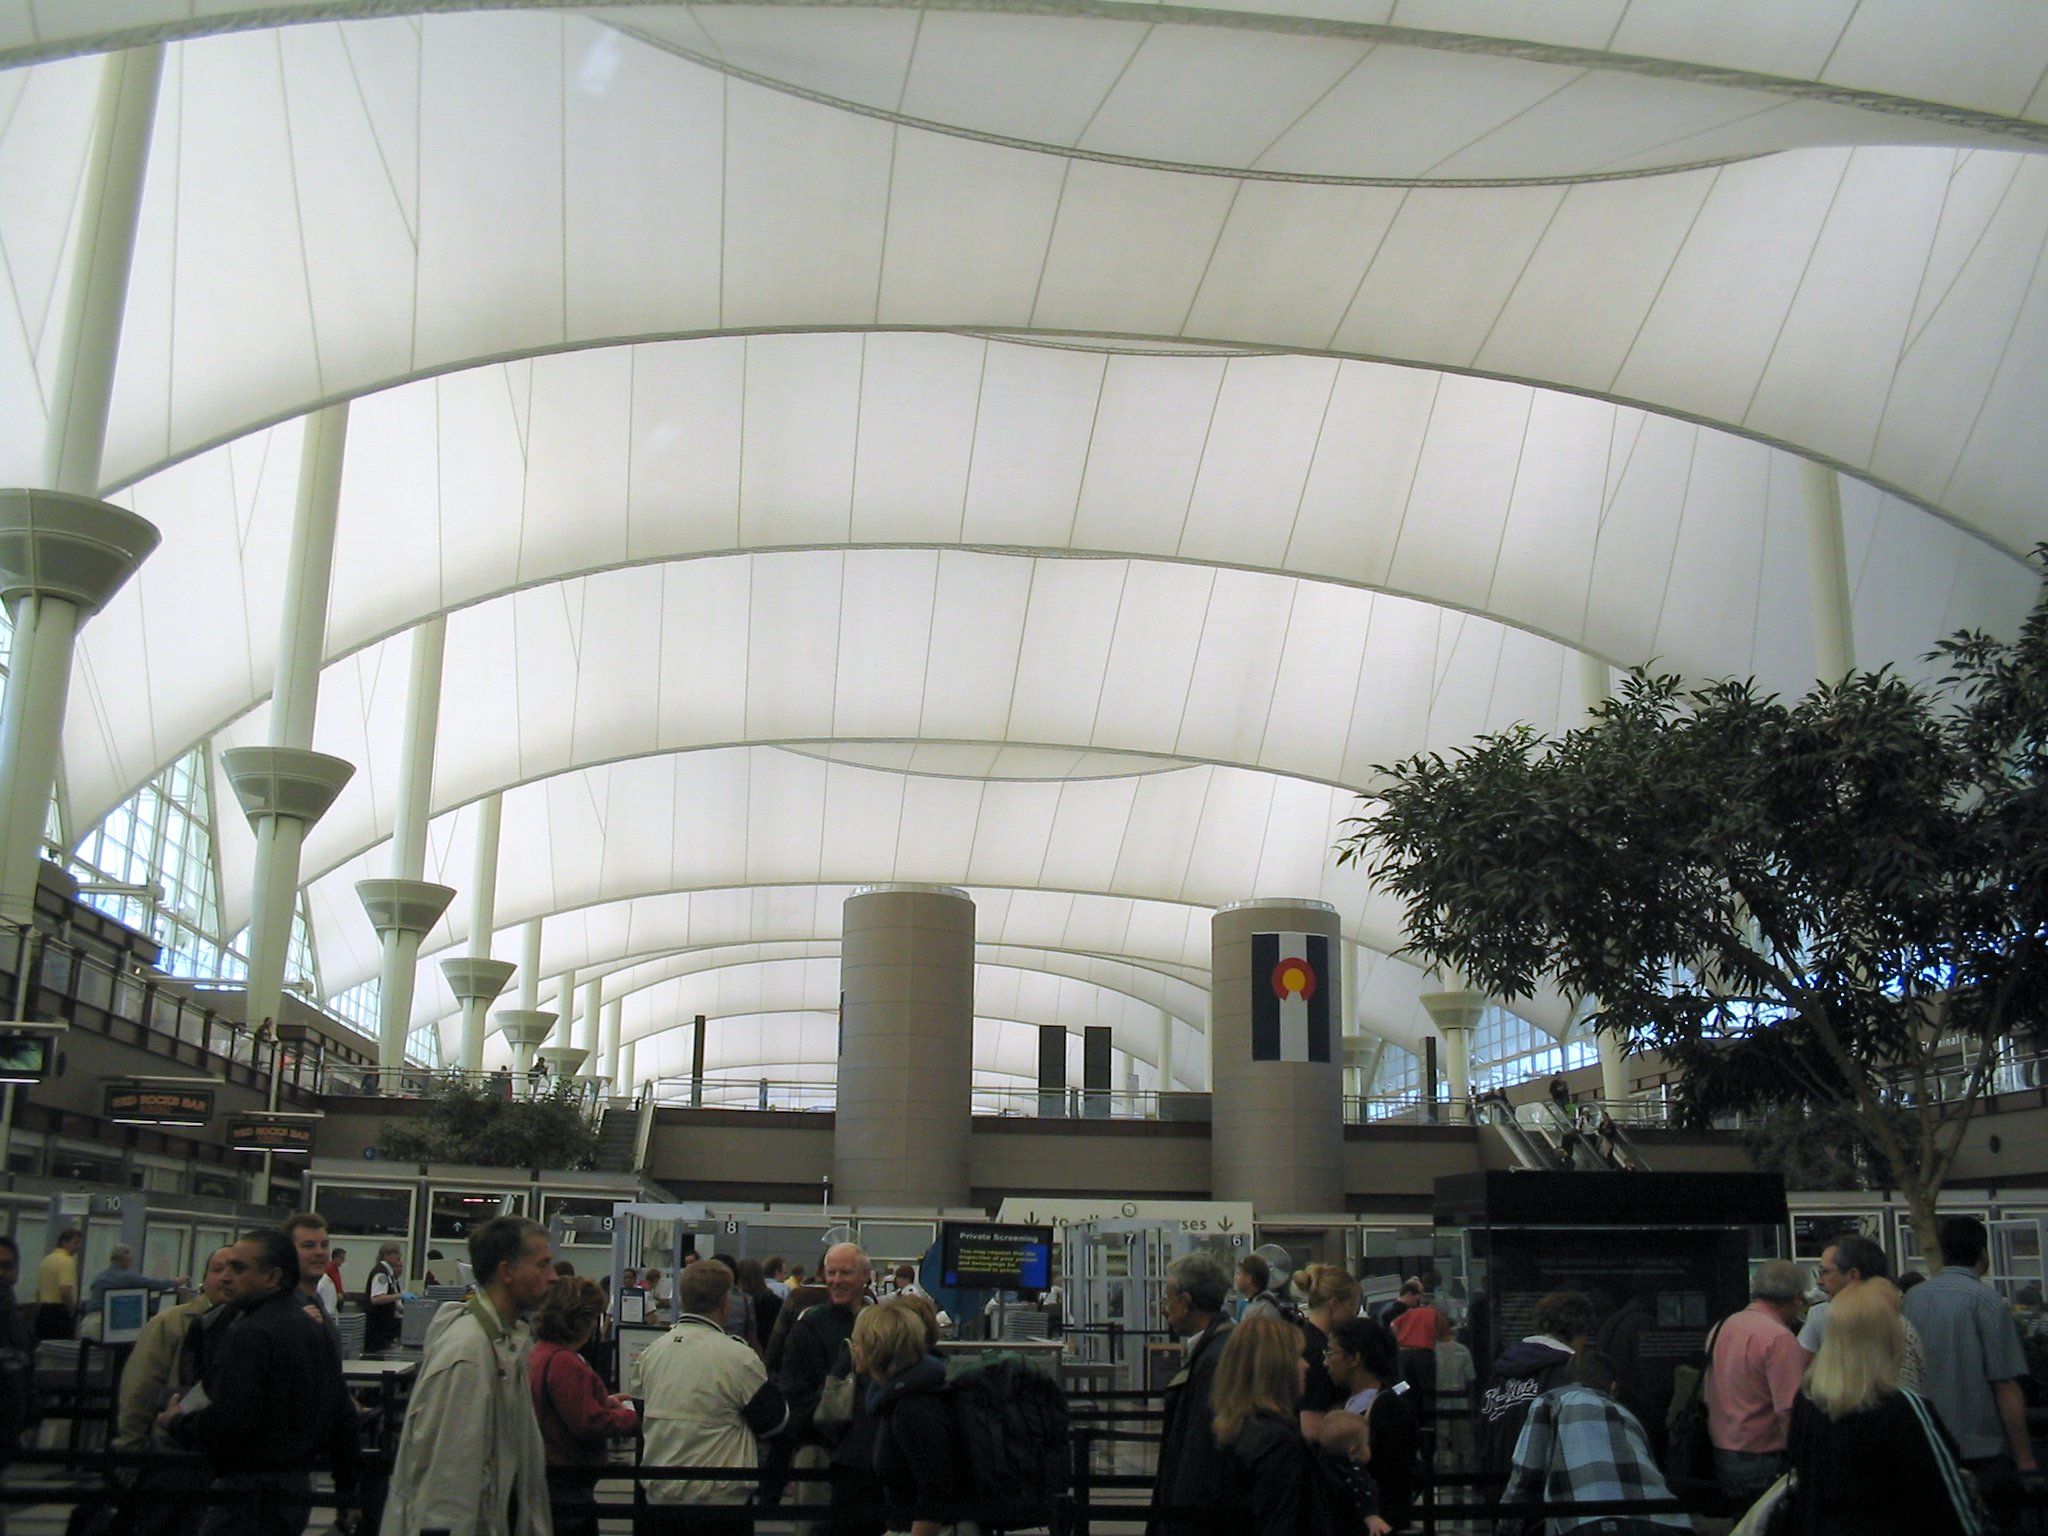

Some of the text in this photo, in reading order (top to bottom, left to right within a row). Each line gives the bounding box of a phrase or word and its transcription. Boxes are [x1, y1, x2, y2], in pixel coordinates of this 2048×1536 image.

[106, 1197, 121, 1210] 10
[603, 1217, 613, 1230] 9
[726, 1221, 737, 1234] 8
[960, 1231, 1038, 1244] Private Screening
[1126, 1232, 1134, 1245] 7
[1232, 1234, 1242, 1247] 6
